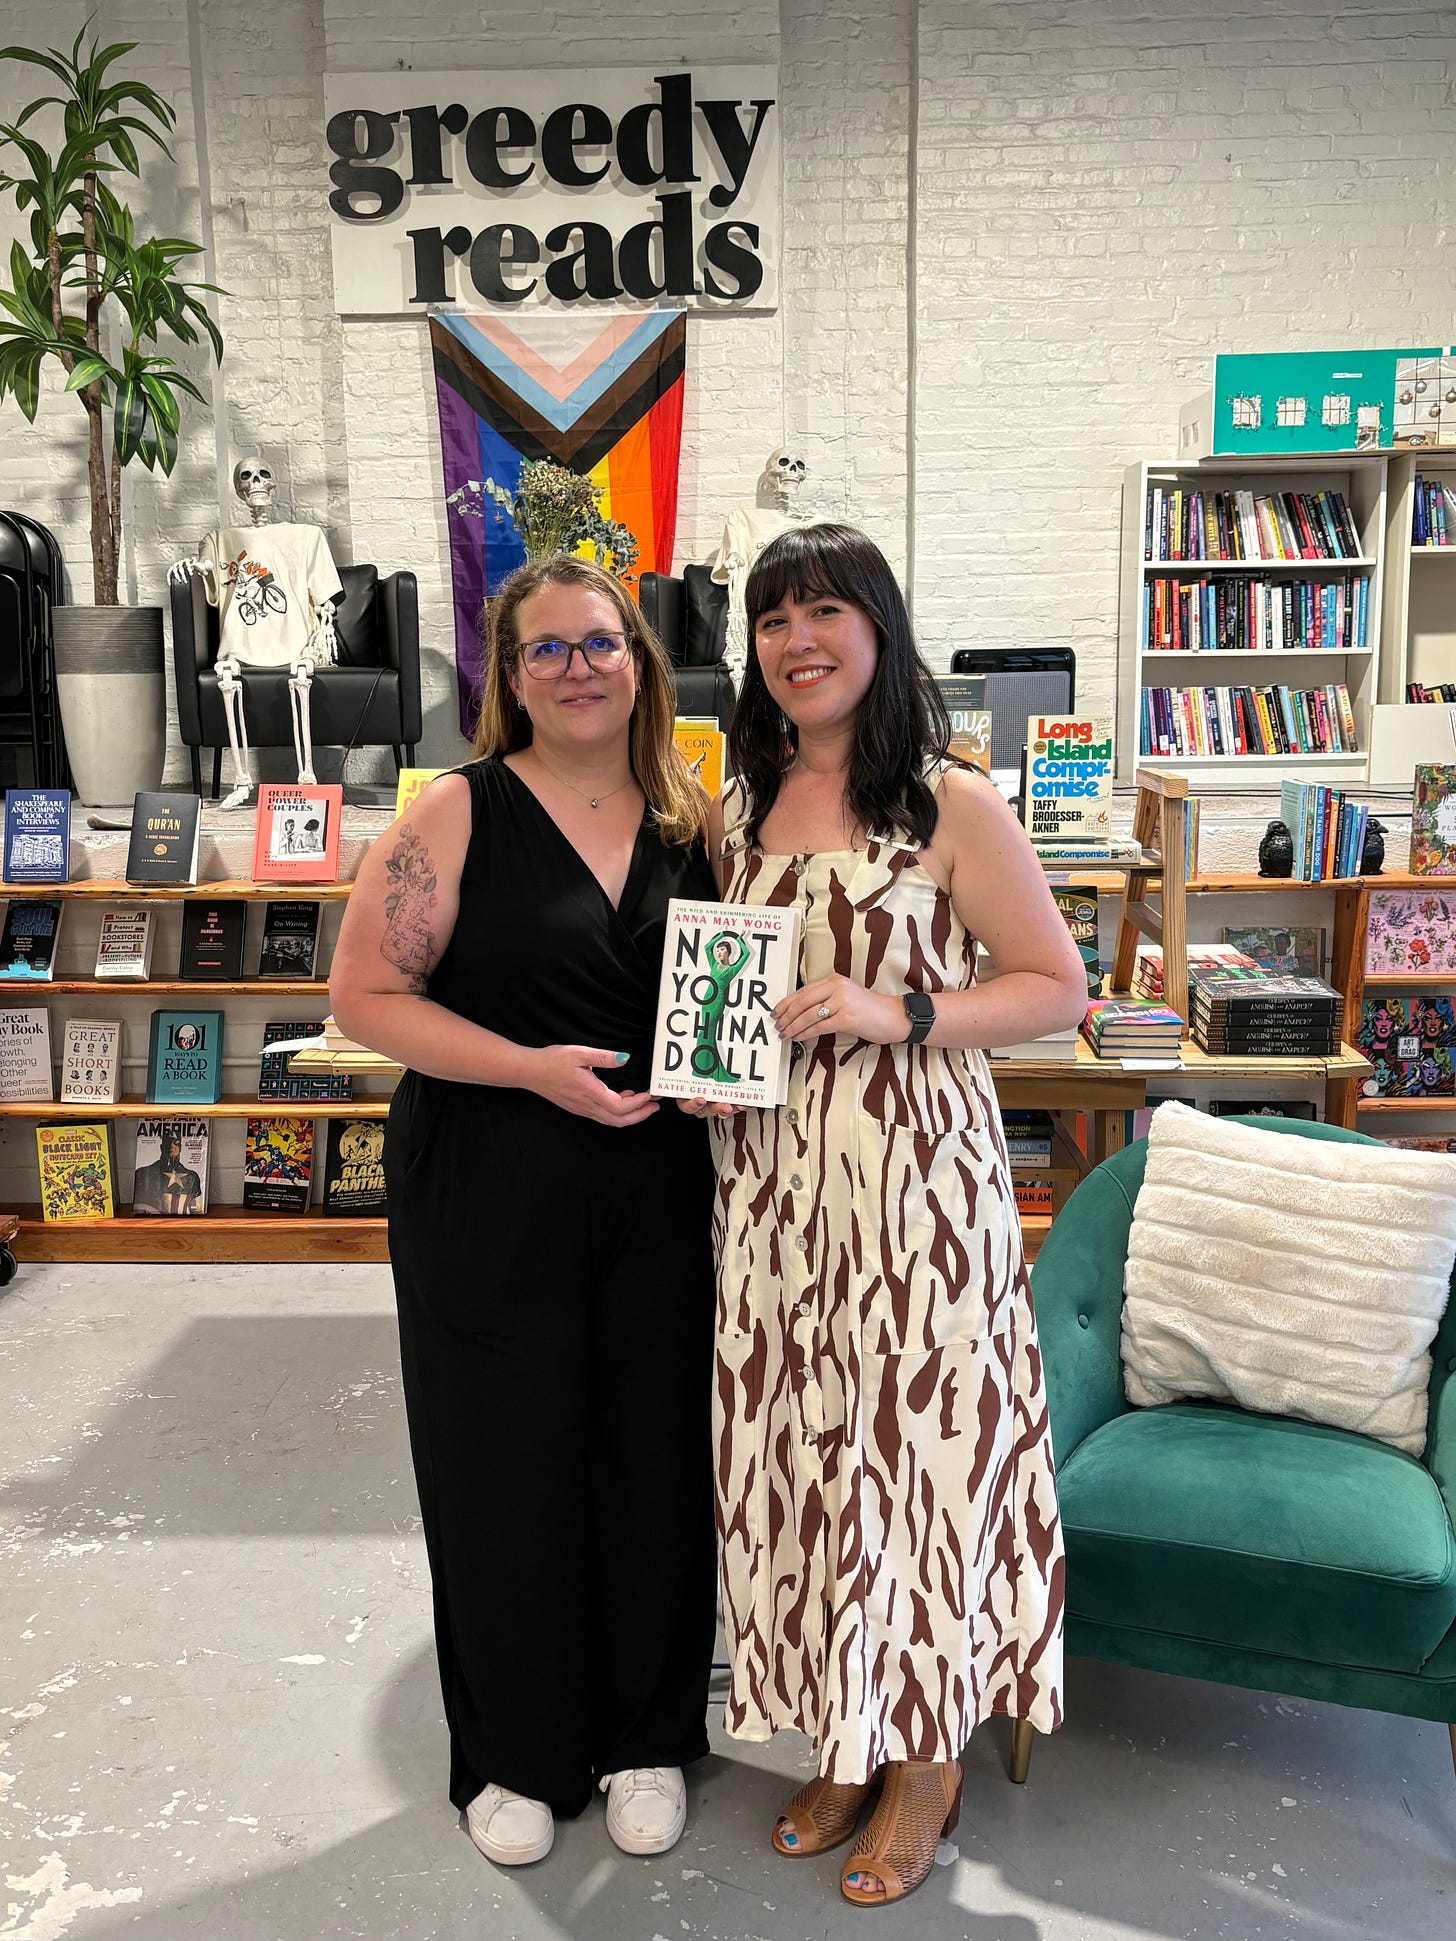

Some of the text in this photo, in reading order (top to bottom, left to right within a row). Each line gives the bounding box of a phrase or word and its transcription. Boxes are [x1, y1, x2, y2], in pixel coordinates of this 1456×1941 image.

[326, 73, 775, 219] greedy
[406, 191, 763, 302] reads
[951, 711, 990, 754] OURS
[1038, 719, 1092, 743] Long
[685, 739, 713, 748] COIN
[1048, 739, 1112, 760] Island
[1033, 758, 1111, 780] Compr-
[1032, 777, 1099, 797] omise
[1033, 800, 1057, 810] TAFFY
[1318, 806, 1323, 814] TO
[1033, 812, 1084, 822] BRODESSER-
[147, 818, 181, 831] QUR'AN
[1032, 823, 1059, 833] AKNER
[1060, 850, 1109, 859] Compromise
[1058, 899, 1073, 911] AL
[14, 908, 53, 925] SOUL
[674, 914, 782, 930] ANNA MAY WONG
[10, 923, 54, 936] CULTURE
[676, 928, 778, 975] NOT
[672, 973, 773, 1012] YOUR
[0, 1023, 44, 1038] ay Book
[666, 1009, 769, 1046] CHINA
[0, 1036, 32, 1047] ories of
[69, 1031, 115, 1042] GREAT
[164, 1024, 208, 1051] 101
[0, 1048, 26, 1057] owth,
[0, 1058, 37, 1068] elonging
[67, 1058, 113, 1069] SHORT
[164, 1059, 208, 1070] READ
[664, 1041, 764, 1081] DOLL
[1, 1069, 27, 1077] Other
[162, 1071, 207, 1080] A BOOK
[0, 1087, 49, 1098] ossibilities
[65, 1084, 110, 1095] BOOKS
[658, 1083, 765, 1100] KATIE GEE SALISBURY
[137, 1123, 208, 1137] AMERICA
[59, 1135, 85, 1143] CLASSIC
[43, 1142, 102, 1153] BLACK LIGHT
[1009, 1142, 1032, 1151] ENRY
[342, 1164, 384, 1179] BLACK
[329, 1177, 386, 1193] PANTHE
[1014, 1192, 1034, 1201] SIAN
